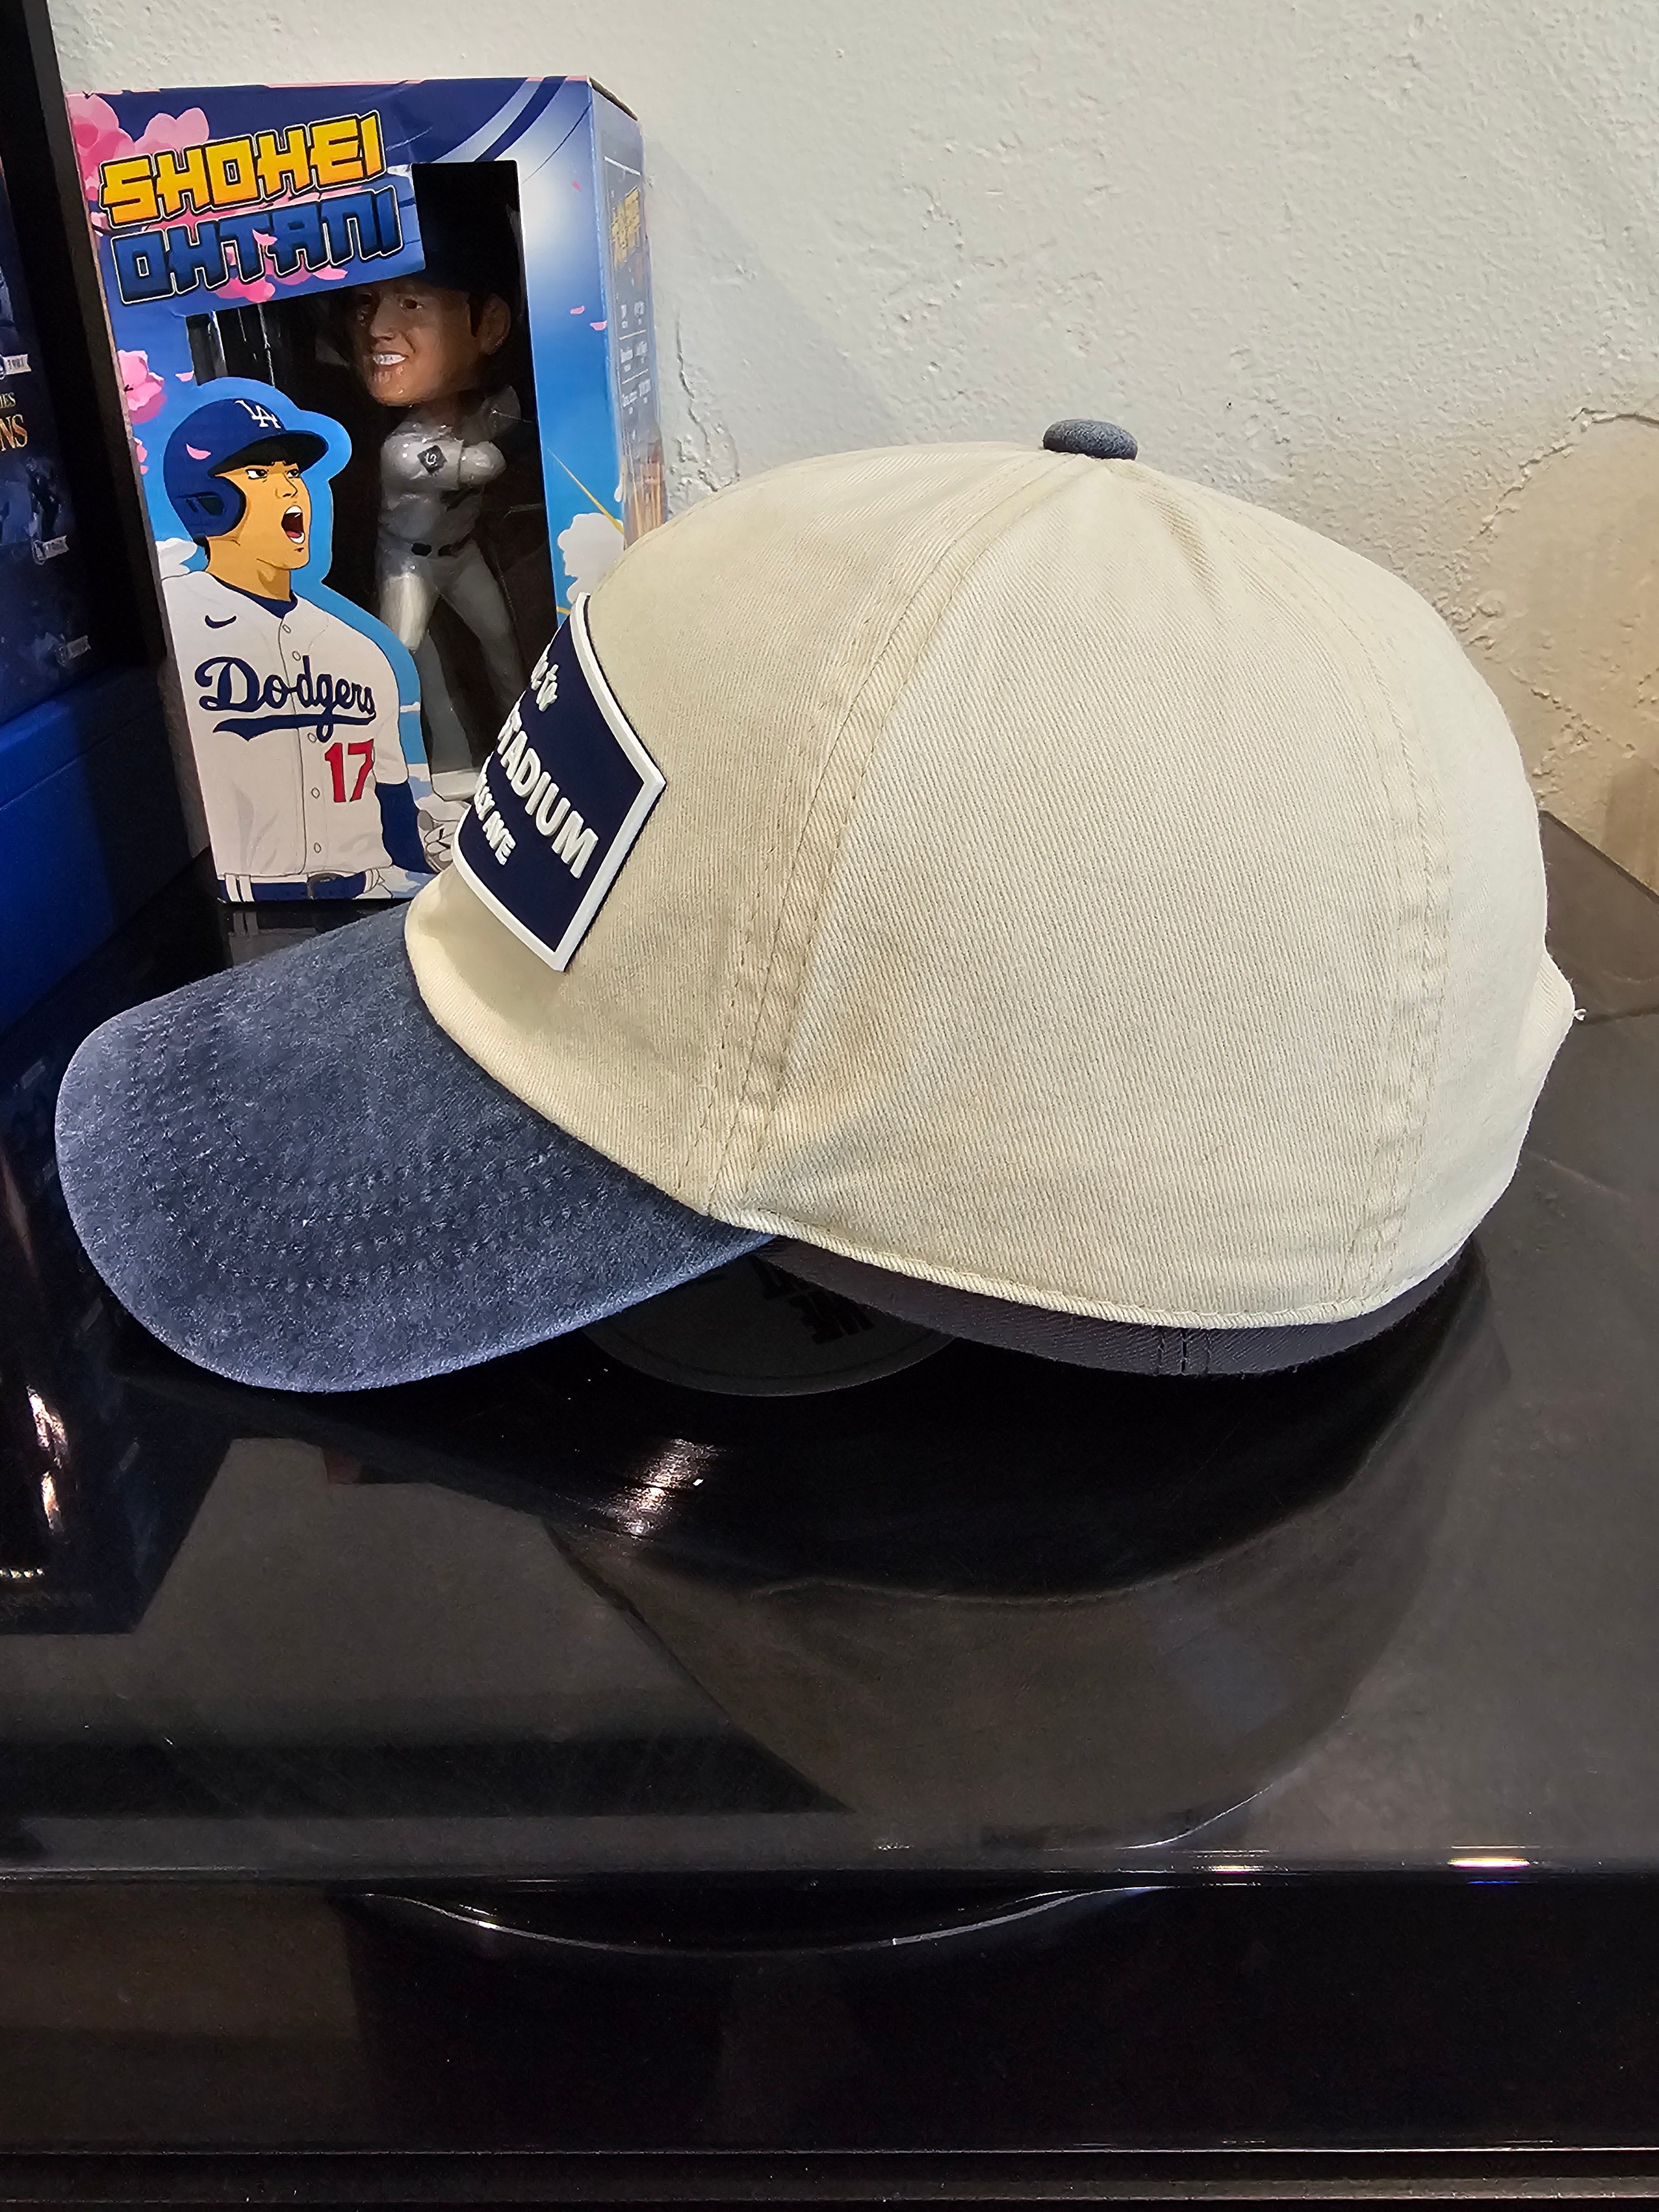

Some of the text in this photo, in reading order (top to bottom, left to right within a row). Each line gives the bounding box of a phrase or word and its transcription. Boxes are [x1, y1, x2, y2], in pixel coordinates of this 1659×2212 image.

[100, 111, 387, 228] SHOHEI
[111, 186, 403, 303] OHTANI
[235, 400, 281, 429] LA
[195, 655, 377, 742] Dodgers
[325, 739, 374, 802] 17
[497, 698, 598, 879] TADIUM
